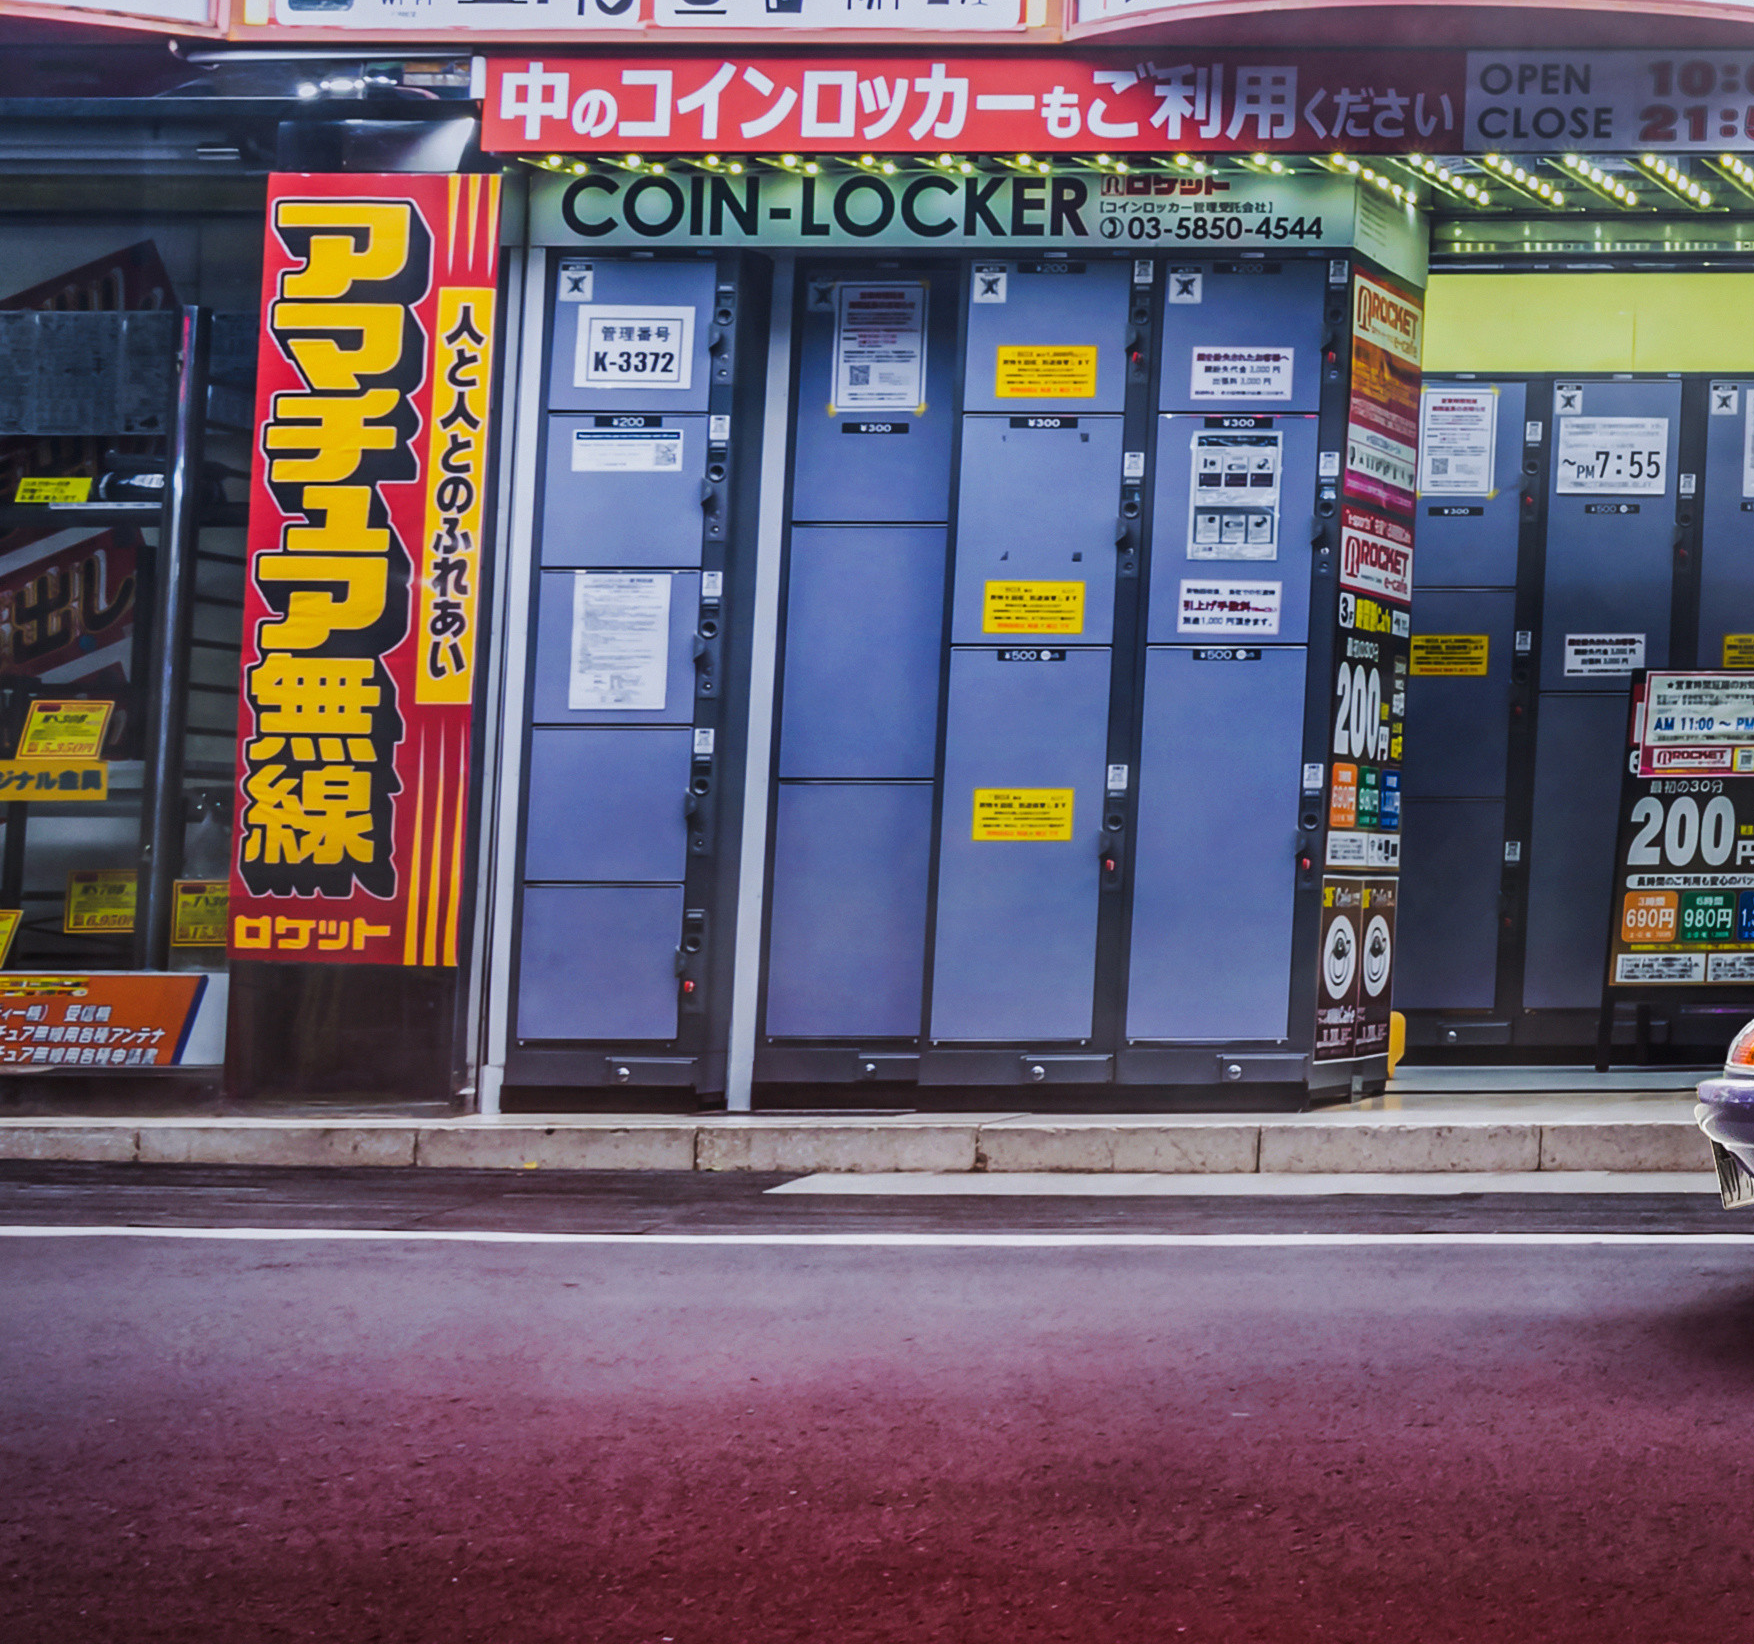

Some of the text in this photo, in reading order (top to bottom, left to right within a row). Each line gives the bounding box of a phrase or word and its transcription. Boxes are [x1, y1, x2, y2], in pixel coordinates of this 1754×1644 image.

[1479, 63, 1591, 95] OPEN
[500, 62, 1453, 141] 中のコインロッカーもご利用ください
[1477, 107, 1613, 139] CLOSE
[1126, 175, 1230, 196] ロケット
[562, 175, 1089, 237] COIN-LOCKER
[1128, 216, 1323, 240] 03-5850-4544
[1371, 292, 1418, 339] ROCKET
[601, 325, 671, 342] 管理番号
[594, 351, 675, 373] K-3372
[860, 424, 892, 433] ¥300
[1028, 419, 1061, 429] ¥300
[1223, 419, 1256, 429] ¥300
[428, 305, 485, 679] 人と人とのふれあい
[243, 201, 425, 874] アマチュア無線
[1361, 539, 1408, 578] ROCKET
[1653, 717, 1675, 731] AM
[1681, 717, 1714, 731] 11:00
[1650, 780, 1724, 794] 最初の30分
[1626, 909, 1675, 928] 690円
[1684, 909, 1733, 928] 980円
[234, 915, 390, 951] ロケット
